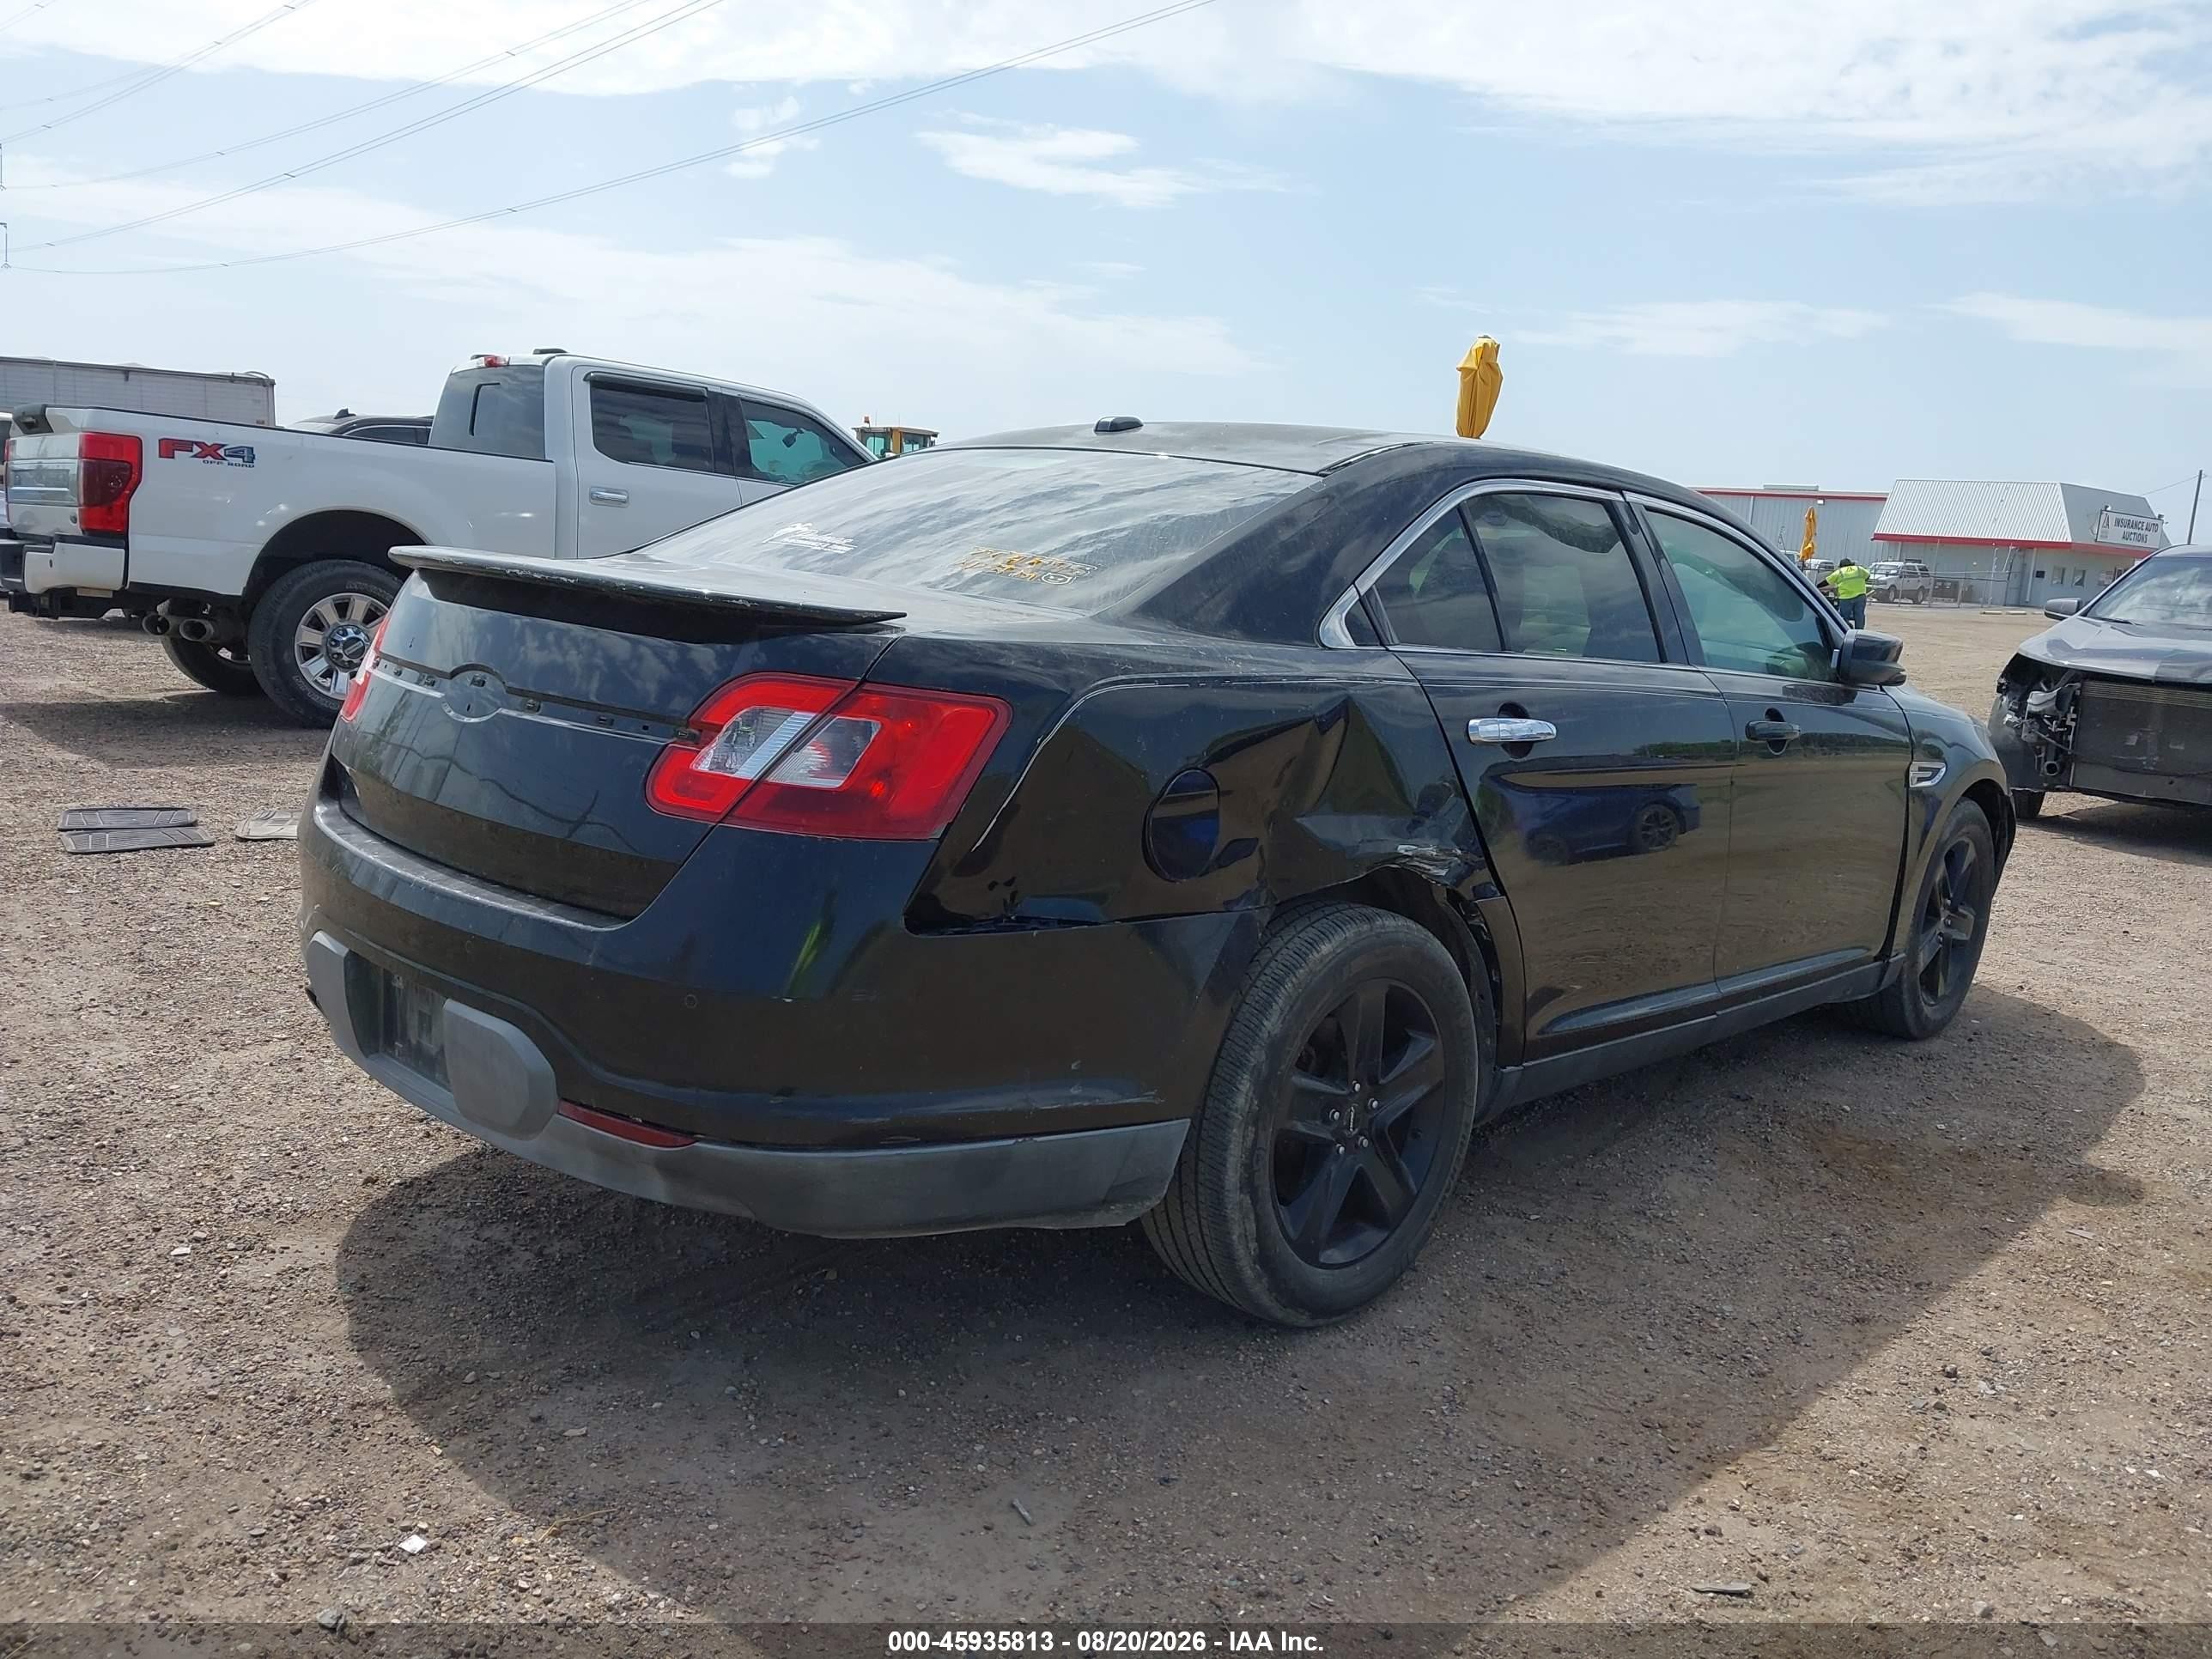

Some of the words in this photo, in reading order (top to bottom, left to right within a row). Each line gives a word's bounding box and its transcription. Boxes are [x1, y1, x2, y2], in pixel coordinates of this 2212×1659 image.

[158, 438, 256, 464] FX4
[2114, 517, 2145, 531] INSURANCE
[2145, 522, 2159, 532] AUTO
[2122, 531, 2148, 544] AUCTIONS
